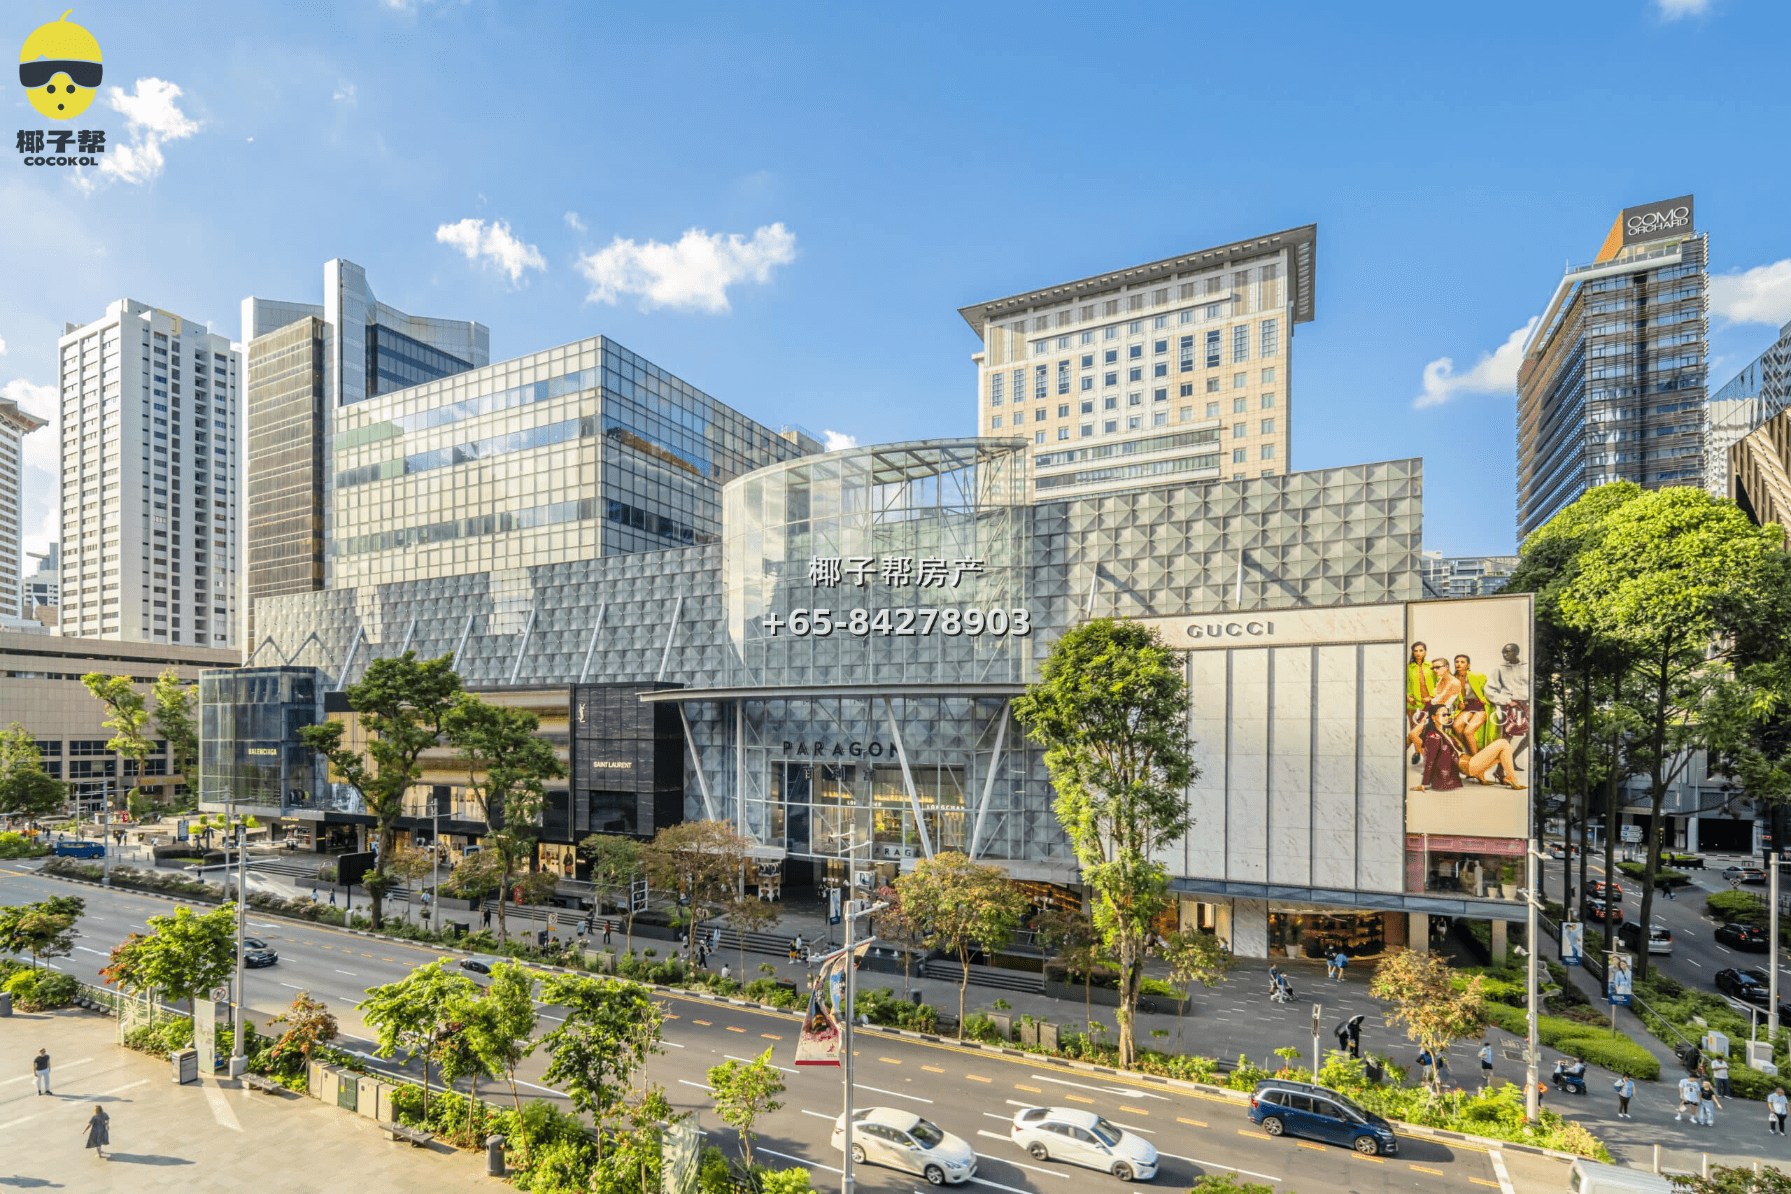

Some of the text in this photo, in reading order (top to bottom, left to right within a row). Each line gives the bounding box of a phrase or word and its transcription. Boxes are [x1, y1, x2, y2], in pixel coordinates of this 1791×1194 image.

[1627, 206, 1690, 228] COMO
[1628, 218, 1689, 236] ORCHARD
[1187, 621, 1274, 638] GUCCI
[1412, 709, 1523, 726] GUCCI
[593, 761, 633, 769] SAINT LAURENT
